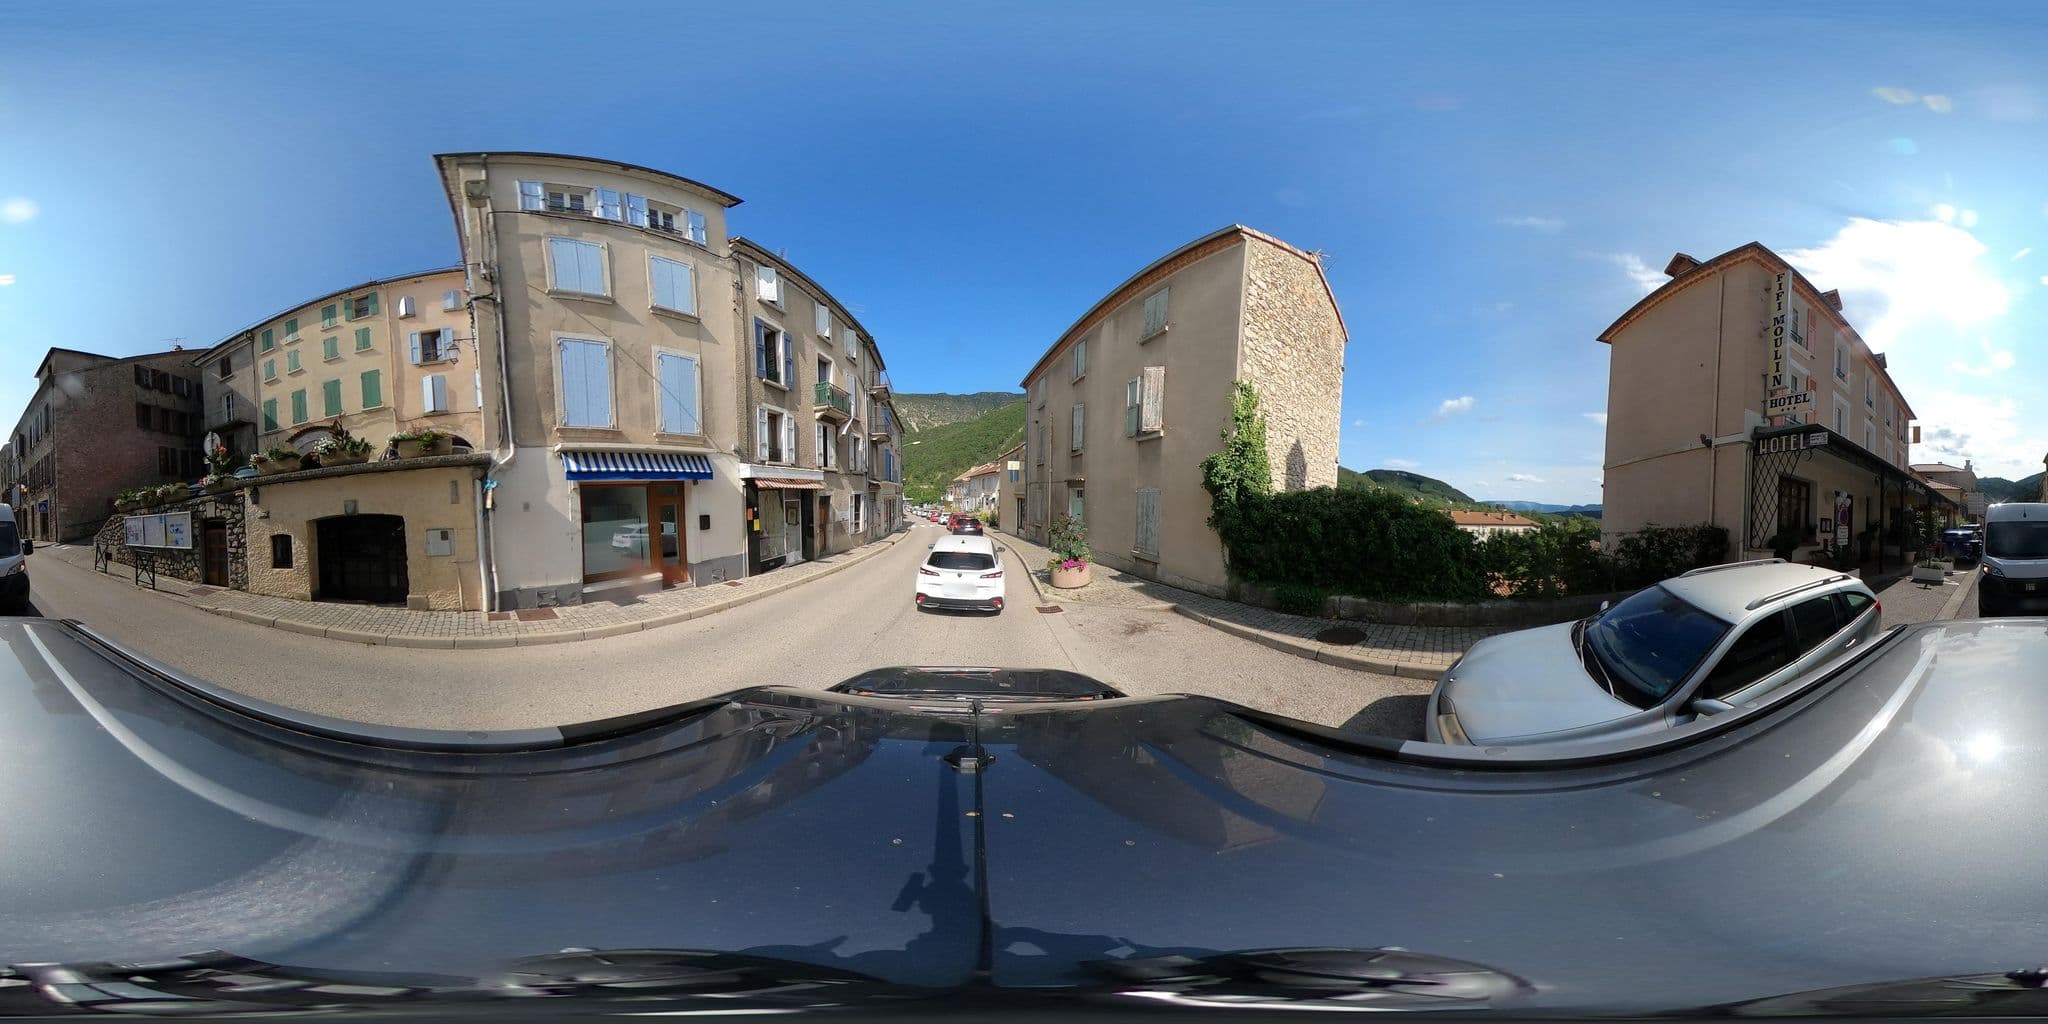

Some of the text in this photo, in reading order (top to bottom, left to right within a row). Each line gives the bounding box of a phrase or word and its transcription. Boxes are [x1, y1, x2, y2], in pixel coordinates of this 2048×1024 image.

[1773, 272, 1785, 387] FIFI MOULIN
[1769, 393, 1810, 408] HOTEL
[1760, 433, 1807, 455] HOTEL
